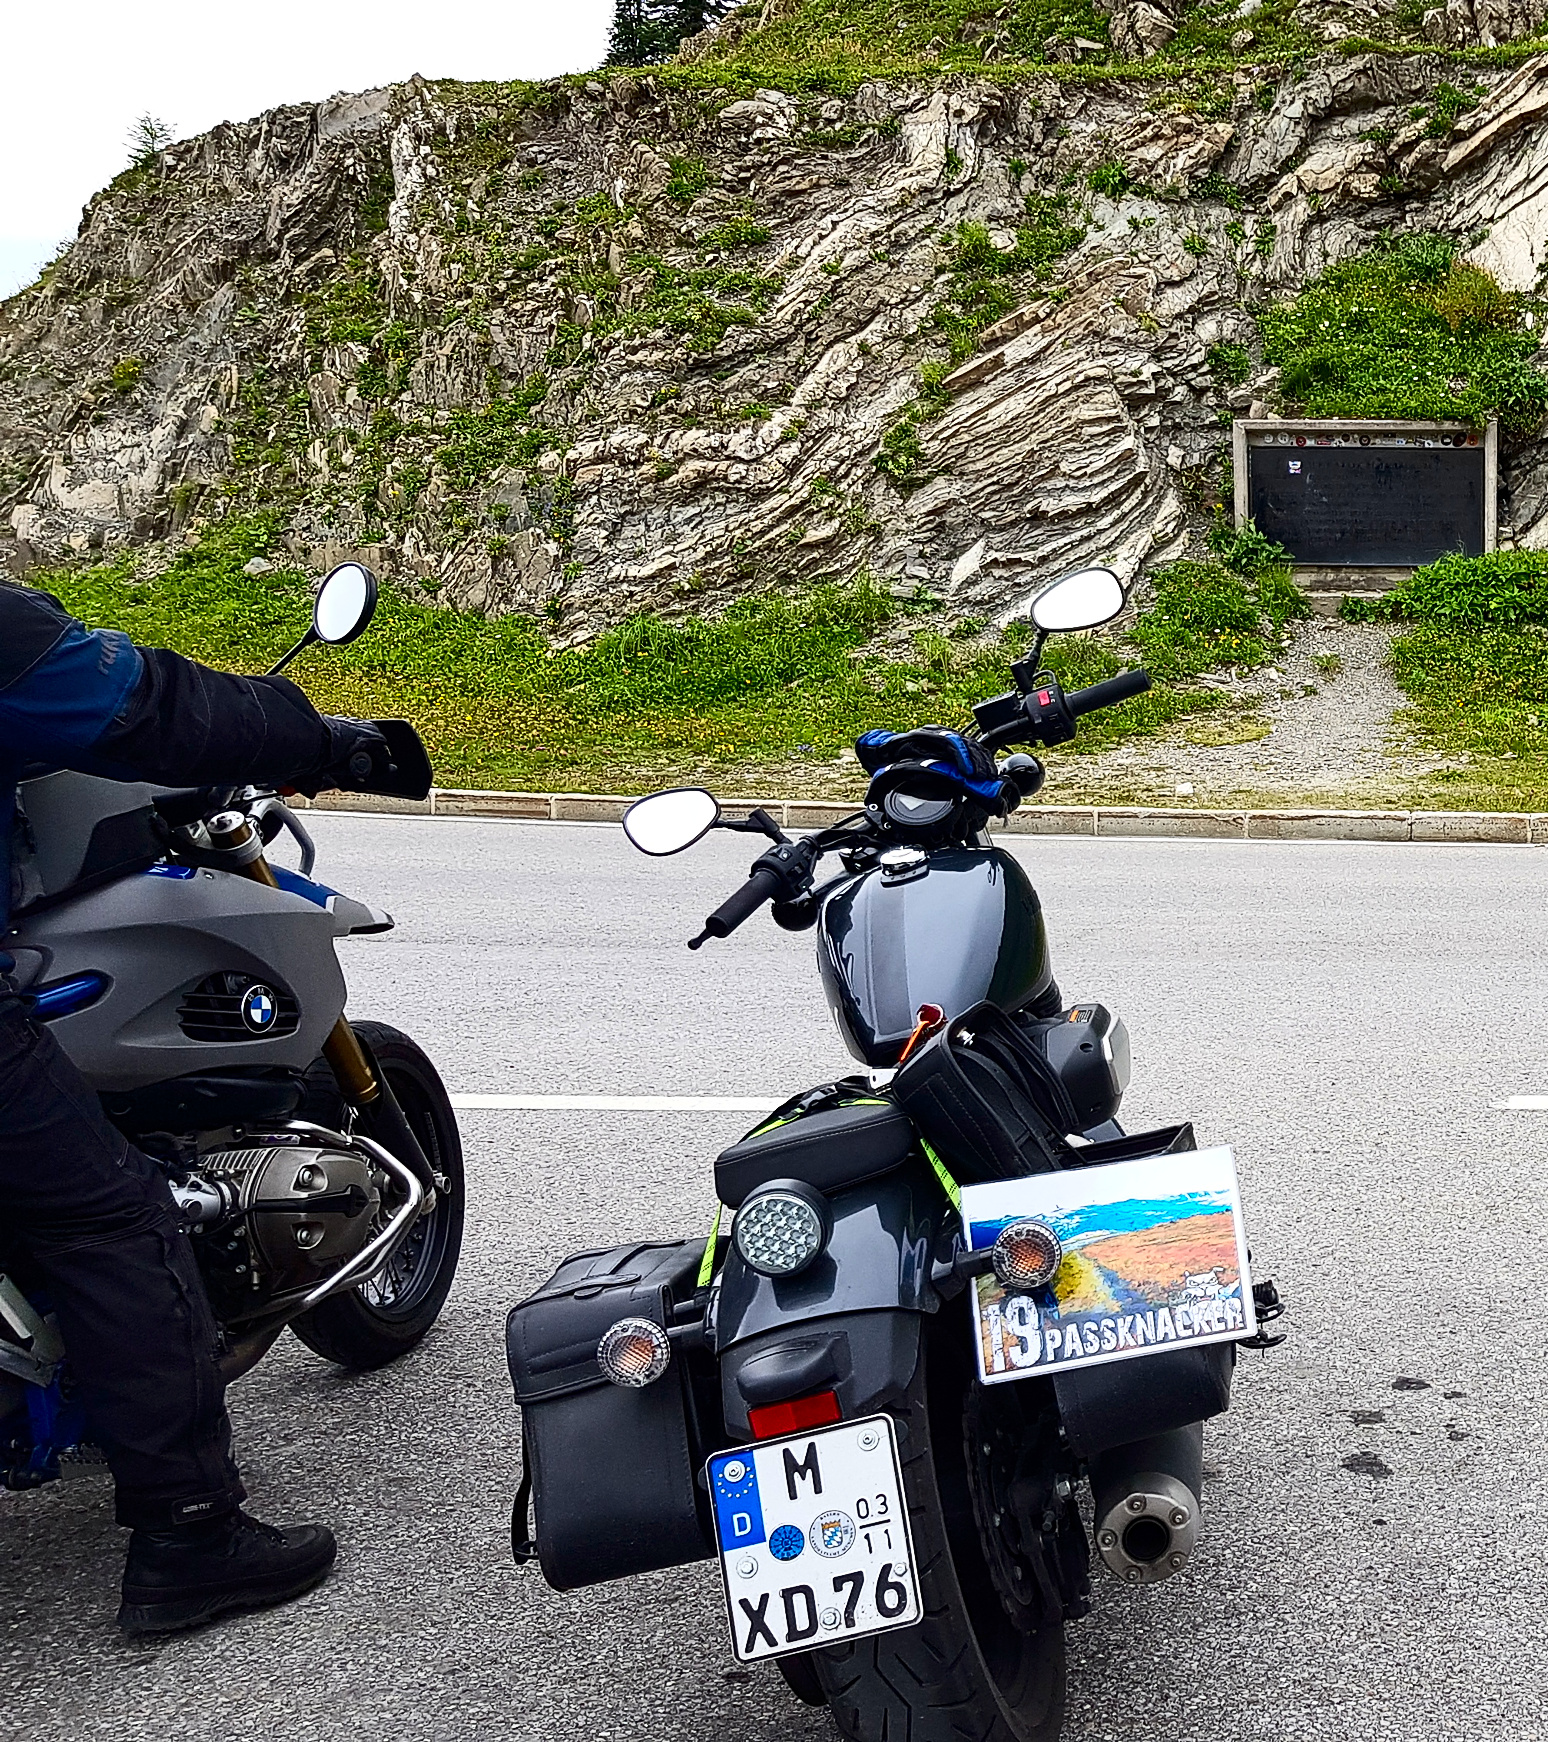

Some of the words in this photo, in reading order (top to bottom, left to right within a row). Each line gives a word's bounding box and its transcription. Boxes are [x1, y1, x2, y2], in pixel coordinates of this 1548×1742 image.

[247, 987, 274, 1002] BMW
[983, 1294, 1043, 1373] 19
[1045, 1294, 1246, 1362] PASSKNACKER
[782, 1441, 823, 1501] M
[856, 1493, 890, 1520] 03
[732, 1512, 752, 1537] D
[863, 1528, 893, 1555] 11
[738, 1584, 819, 1654] XD
[832, 1562, 908, 1629] 76
